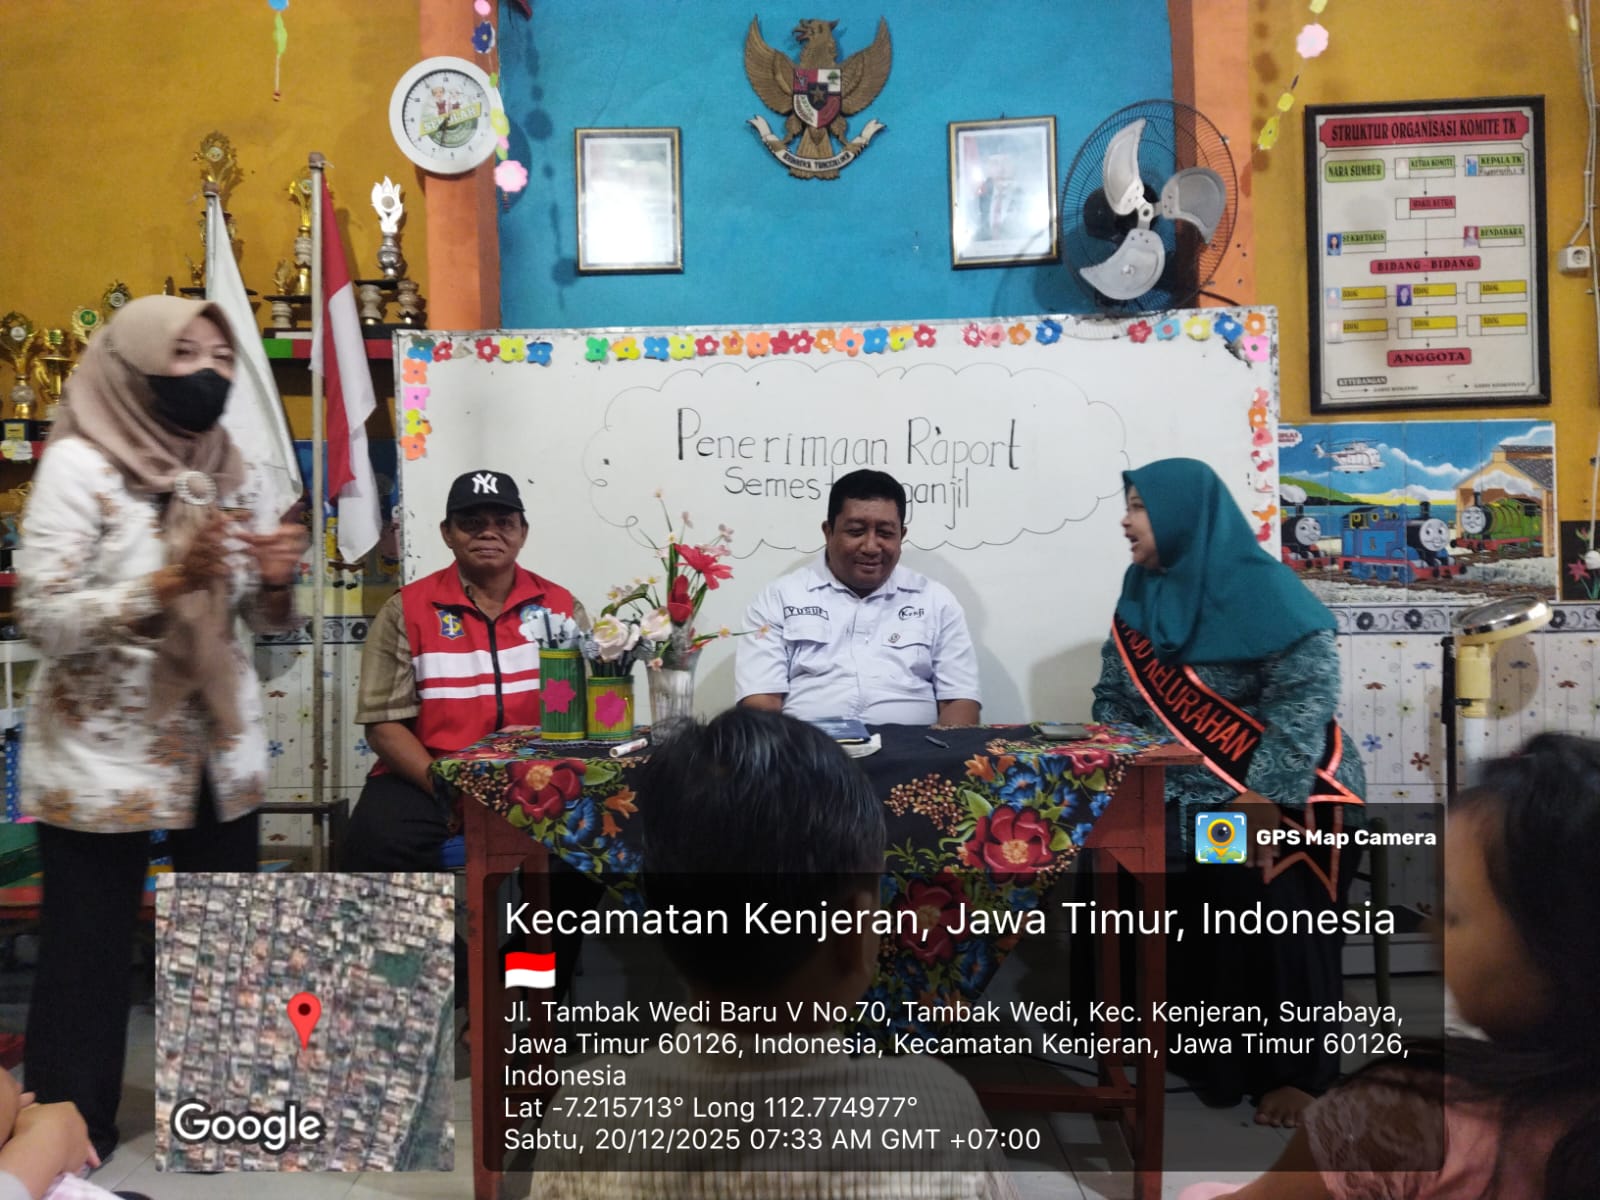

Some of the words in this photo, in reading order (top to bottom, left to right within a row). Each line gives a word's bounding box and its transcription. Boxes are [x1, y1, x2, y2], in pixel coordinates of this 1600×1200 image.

[1331, 123, 1389, 142] STRUKTUR
[1391, 120, 1457, 139] ORGANISASI
[1460, 118, 1501, 135] KOMITE
[1502, 116, 1517, 134] TK
[1480, 155, 1510, 166] KEPALA
[1328, 165, 1349, 177] NARA
[1350, 163, 1382, 176] SUMBER
[1377, 261, 1421, 272] BIDANG
[1431, 258, 1475, 270] BIDANG
[1392, 351, 1466, 364] ANGGOTA
[677, 407, 888, 466] Penerimaan
